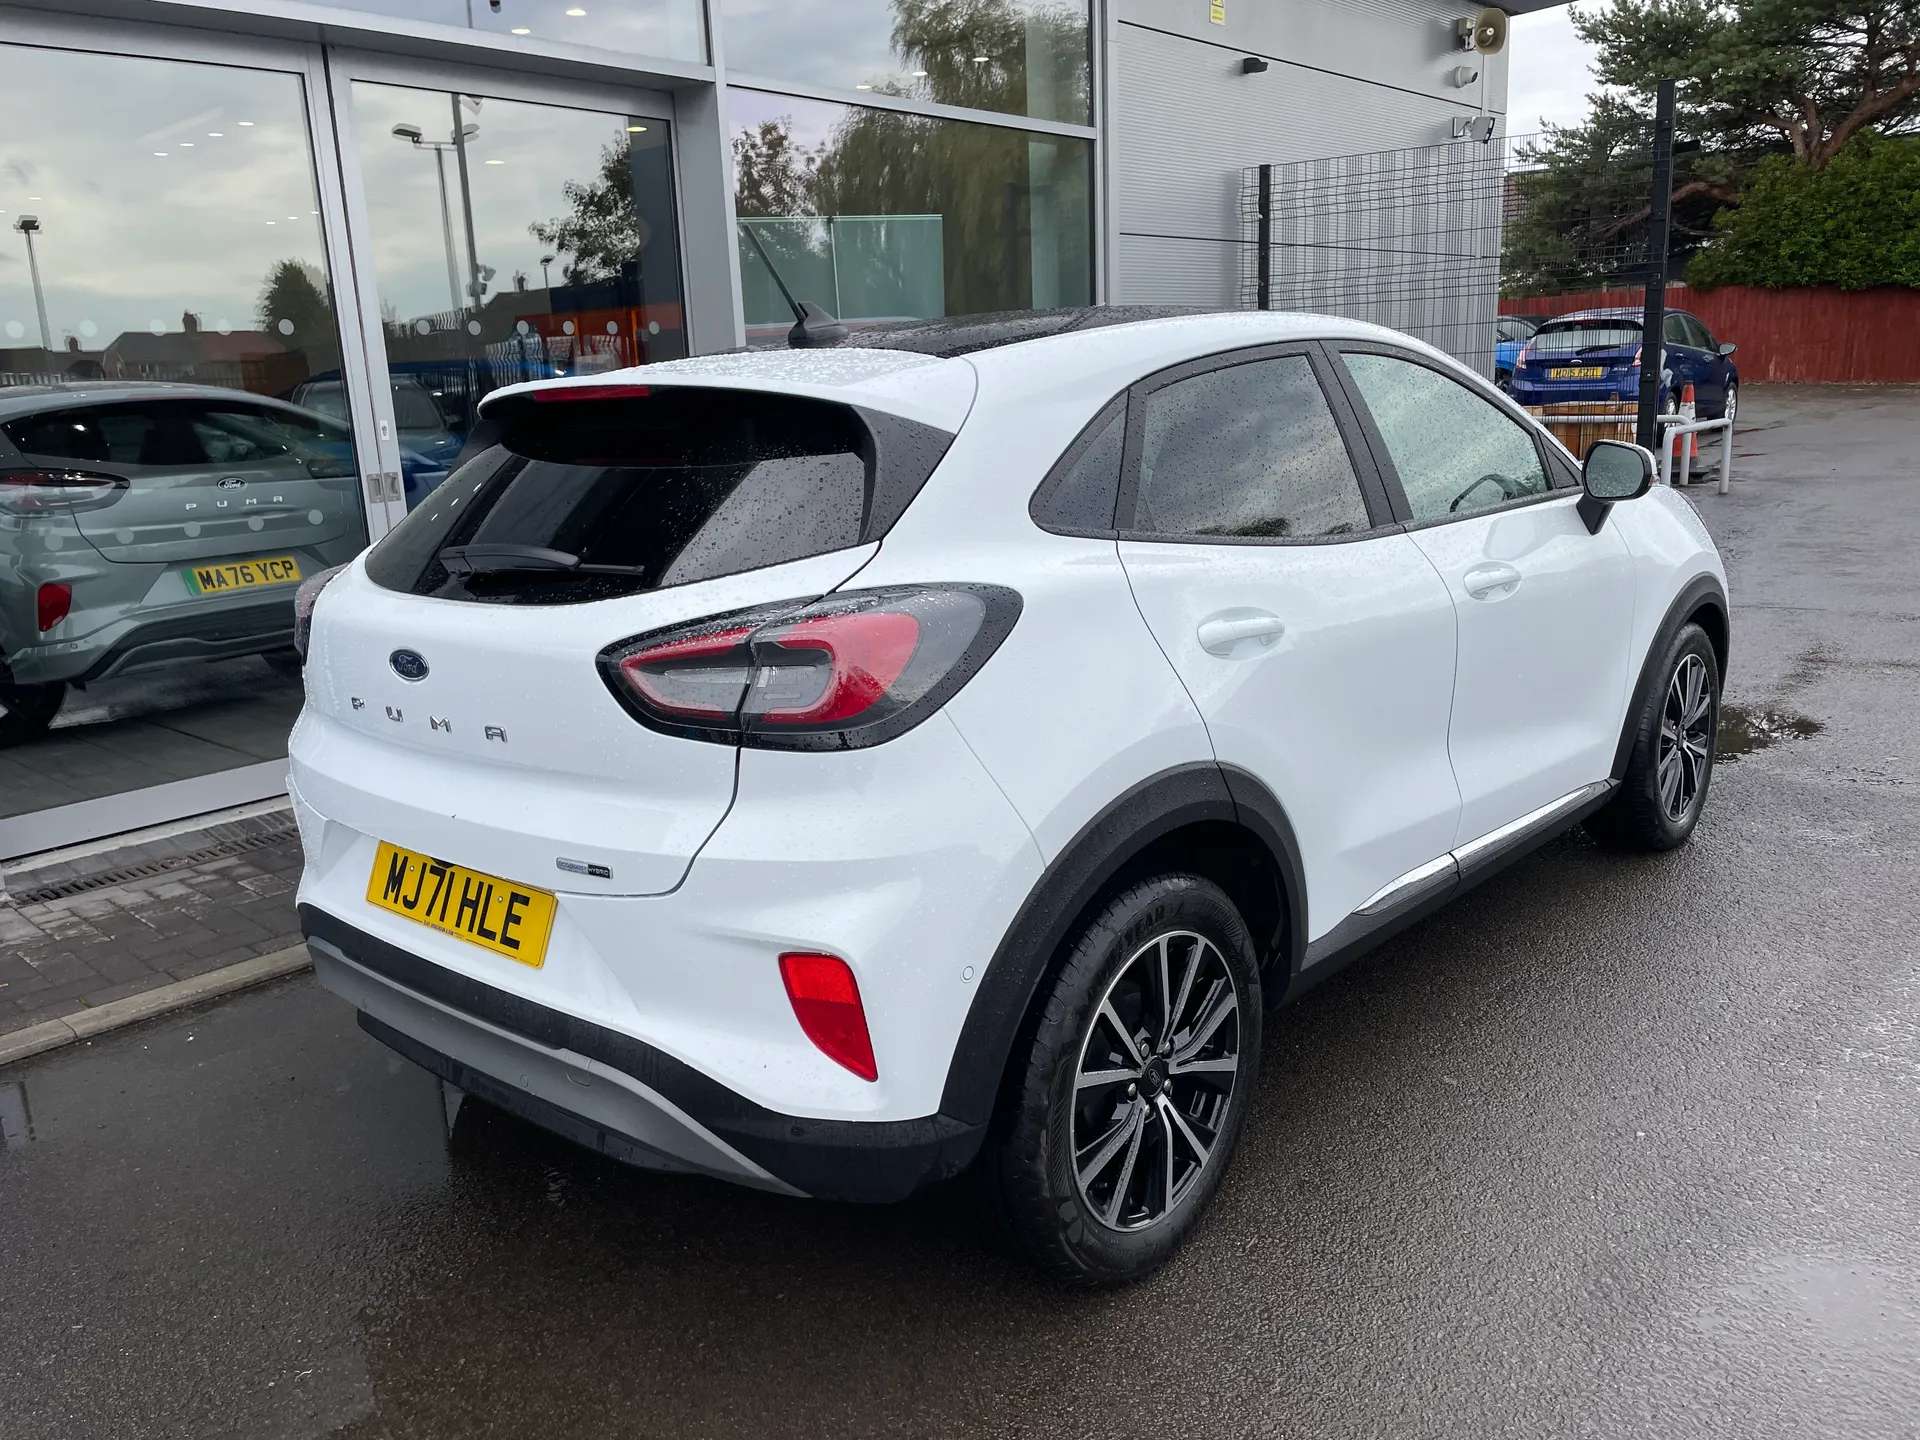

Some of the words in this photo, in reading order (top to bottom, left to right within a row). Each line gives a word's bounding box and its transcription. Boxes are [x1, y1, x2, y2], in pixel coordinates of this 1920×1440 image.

[186, 495, 283, 511] PUMA
[198, 565, 255, 590] MA76
[256, 560, 294, 581] YCP
[398, 653, 421, 674] Ford
[351, 697, 508, 743] PUMA
[383, 852, 455, 922] MJ71
[455, 876, 531, 951] HLE
